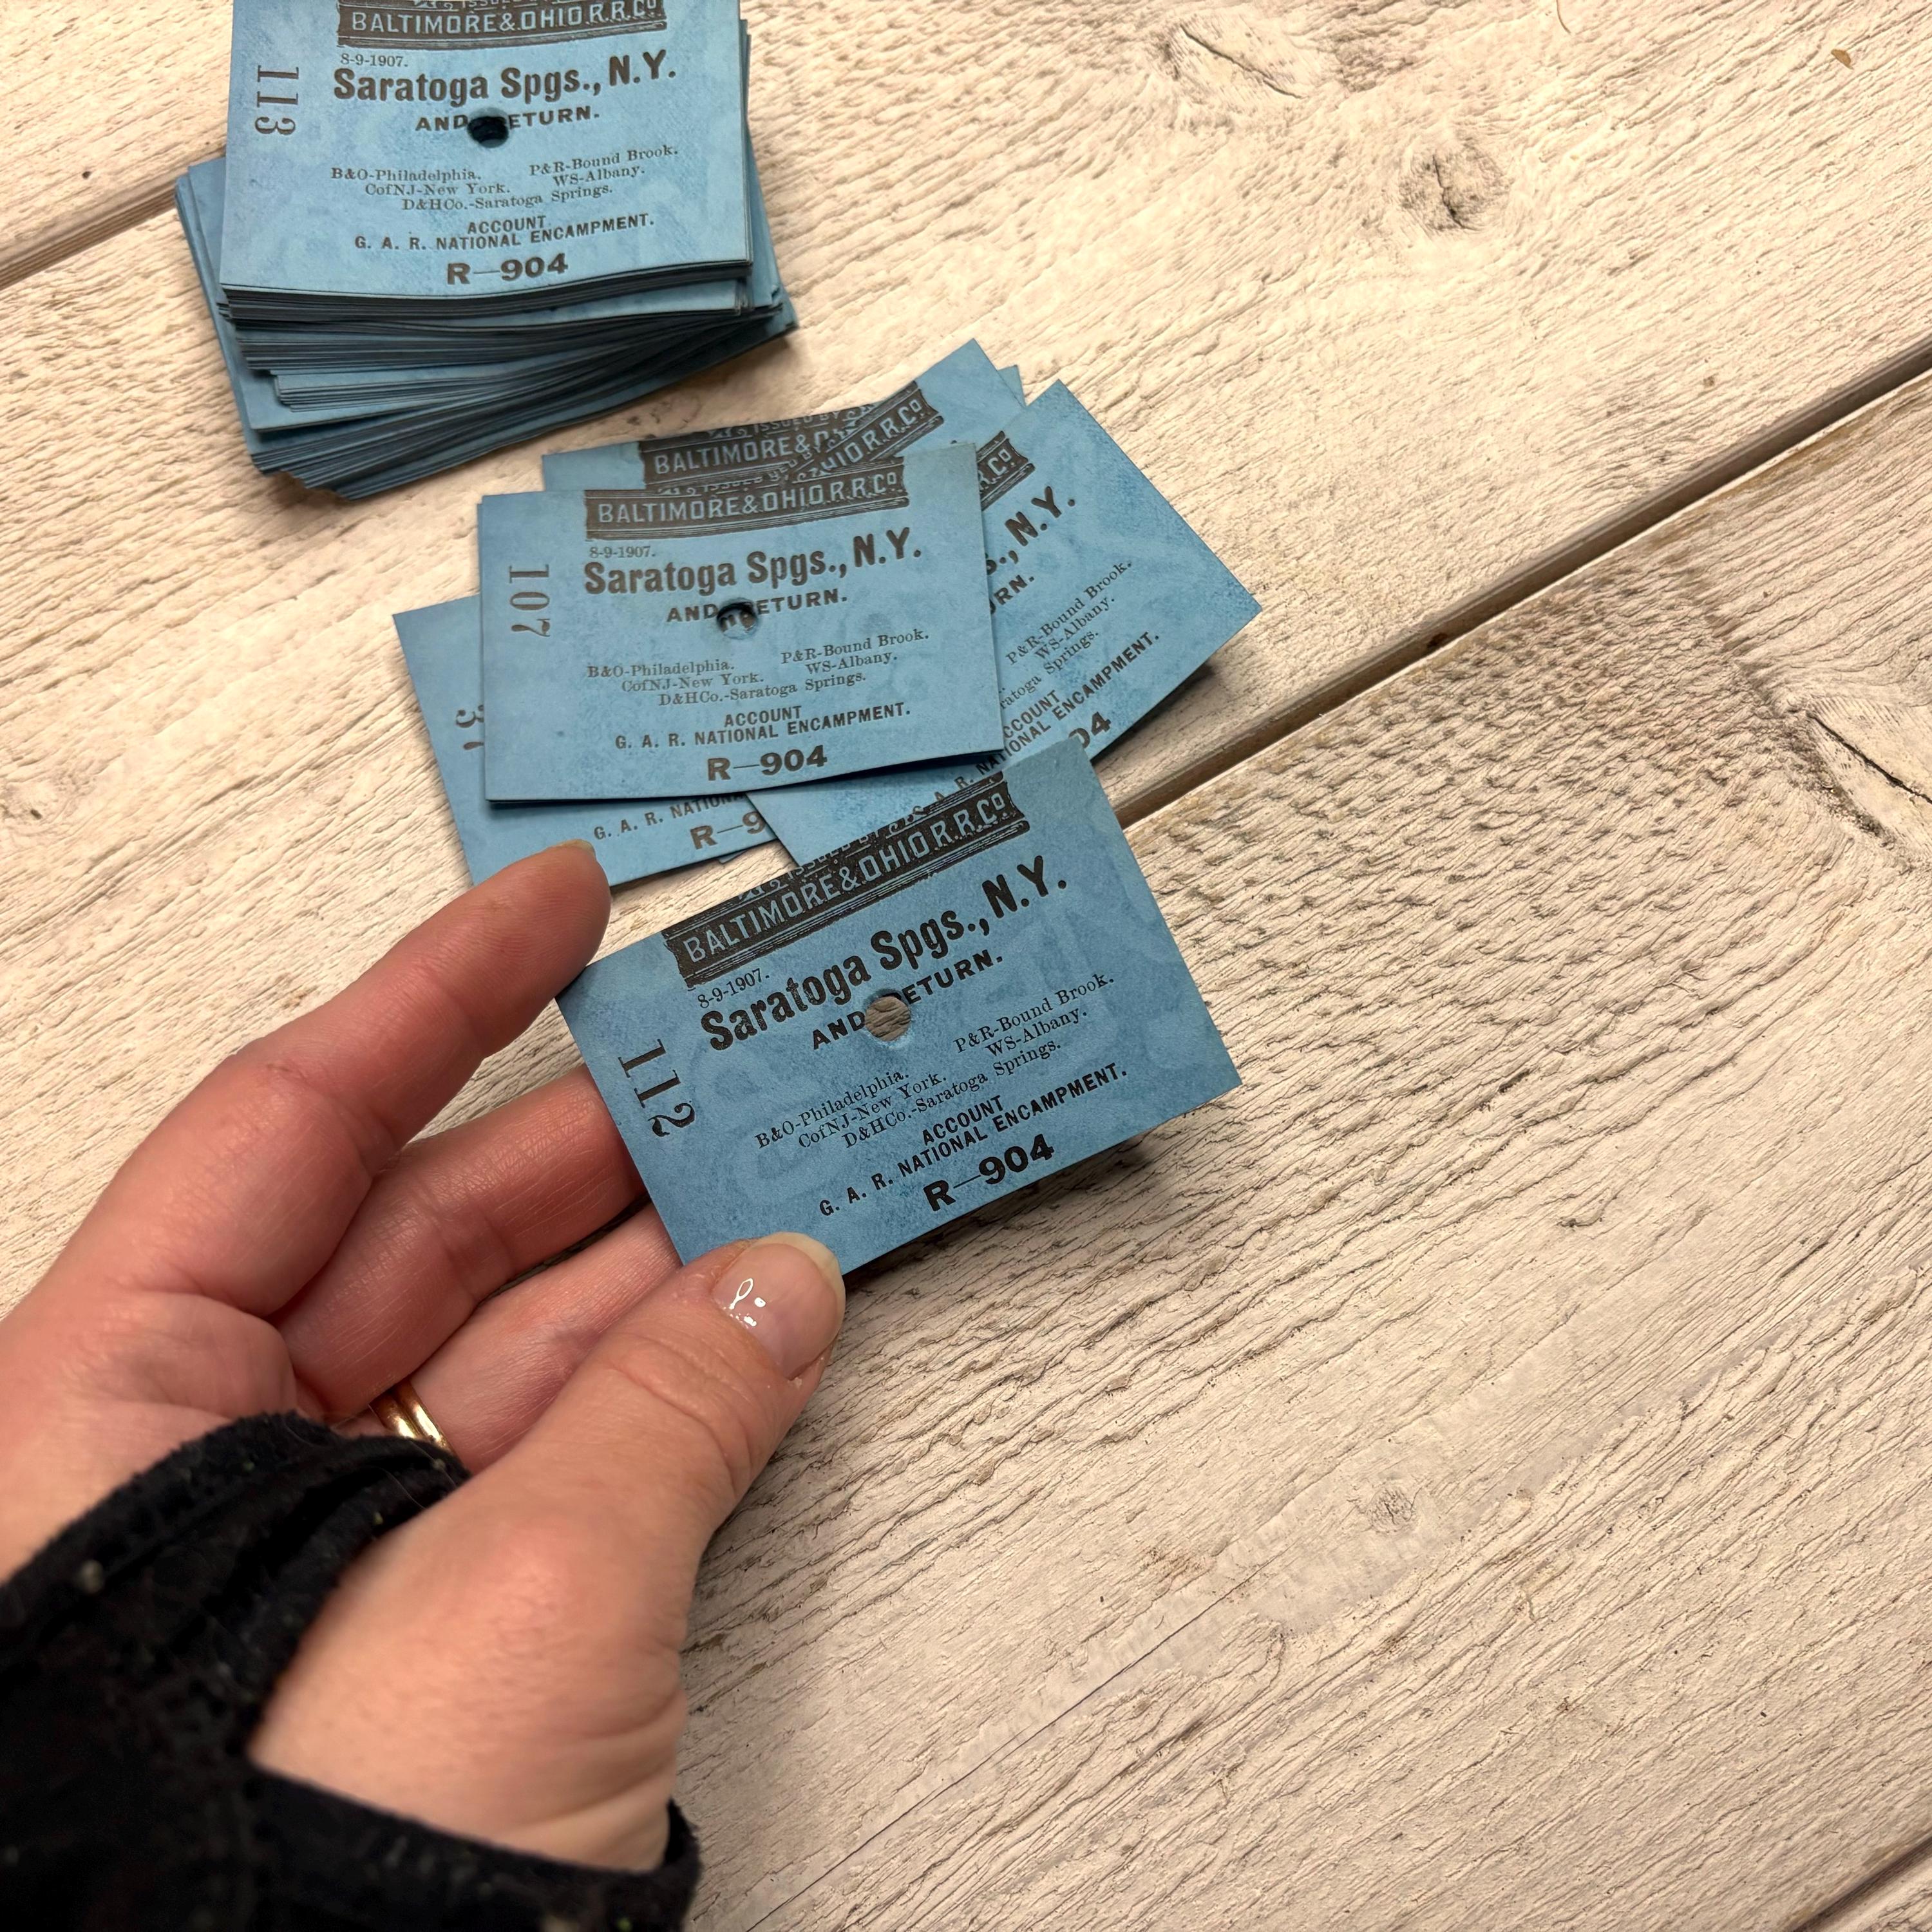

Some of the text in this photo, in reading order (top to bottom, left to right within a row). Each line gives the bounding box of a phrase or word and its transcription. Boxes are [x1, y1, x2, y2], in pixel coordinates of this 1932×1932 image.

[334, 49, 676, 108] Saratoga Spgs., N.Y.
[340, 53, 408, 67] 8-9-1907.
[255, 65, 299, 135] 113
[415, 106, 600, 131] AND ETURN.
[331, 167, 482, 183] B&O-Philadelphia.
[529, 144, 678, 176] P&R-Bound Brook.
[553, 165, 645, 187] WS-Albany.
[401, 185, 613, 211] D&HCo.-Saratoga Springs.
[466, 182, 511, 194] York.
[355, 213, 654, 250] G. A. R. NATIONAL ENCAMPMENT.
[467, 215, 547, 234] ACCOUNT
[1005, 486, 1075, 547] N.Y.
[584, 527, 922, 596] Saratoga Spgs., N.Y.
[589, 545, 656, 558] 8-9-1907.
[509, 564, 550, 638] 107
[667, 603, 719, 623] AND
[756, 588, 848, 615] ETURN.
[1005, 560, 1132, 665] P&R-Bound Brook.
[781, 629, 929, 664] P&R-Bound Brook.
[1034, 596, 1115, 660] WS-Albany.
[587, 659, 735, 677] B&O-Philadelphia.
[719, 672, 764, 686] York.
[805, 652, 897, 674] WS-Albany.
[999, 630, 1099, 709] ratoga Springs.
[1052, 631, 1159, 721] ENCAMPMENT.
[658, 672, 866, 706] D&HCo.-Saratoga Springs.
[615, 702, 911, 749] G. A. R. NATIONAL ENCAMPMENT.
[724, 705, 802, 728] ACCOUNT
[1003, 689, 1059, 738] CCOUNT
[594, 826, 612, 840] G.
[620, 819, 638, 833] A.
[644, 811, 663, 826] R.
[701, 855, 1066, 1050] Saratoga Spgs., N.Y.
[697, 968, 770, 1009] 8-9-1907.
[812, 949, 1003, 1050] AND ETURN.
[953, 974, 1114, 1053] P&R-Bound Brook.
[985, 1008, 1087, 1057] WS-Albany.
[618, 1039, 695, 1137] 112
[754, 1071, 909, 1149] B&O-Philadelphia.
[798, 1074, 947, 1148] CofNJ-New York.
[841, 1039, 1061, 1148] D&HCo.-Saratoga Springs.
[819, 1062, 1127, 1216] G. A. R. NATIONAL ENCAMPMENT.
[922, 1095, 1005, 1146] ACCOUNT
